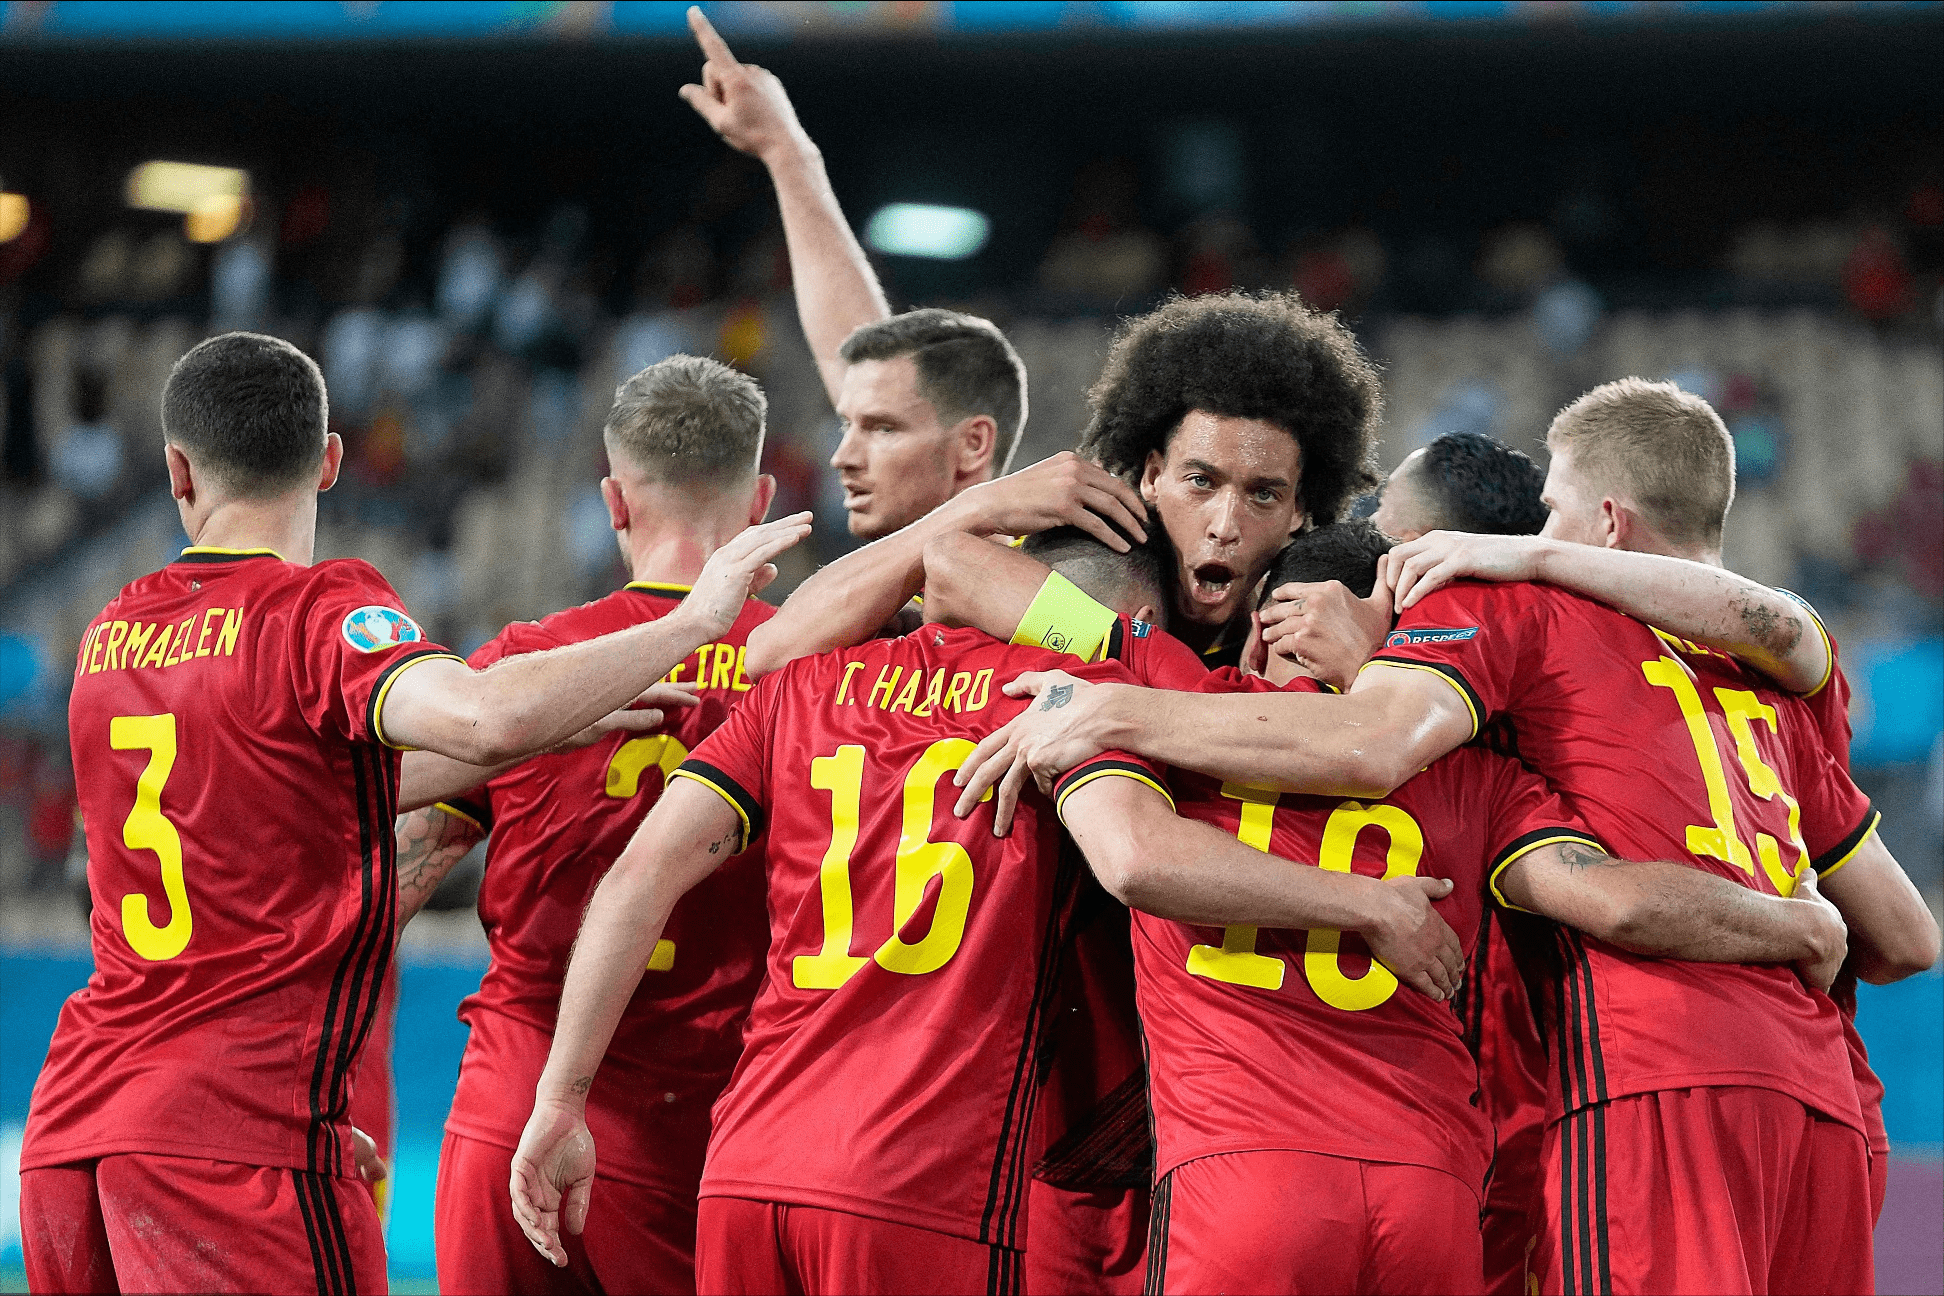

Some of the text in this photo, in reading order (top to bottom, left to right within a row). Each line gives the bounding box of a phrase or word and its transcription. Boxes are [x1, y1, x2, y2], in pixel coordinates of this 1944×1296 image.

[79, 607, 243, 676] VERMAELEN
[835, 661, 866, 706] T.
[110, 713, 193, 961] 3
[792, 737, 994, 990] 16
[1641, 655, 1811, 898] 15
